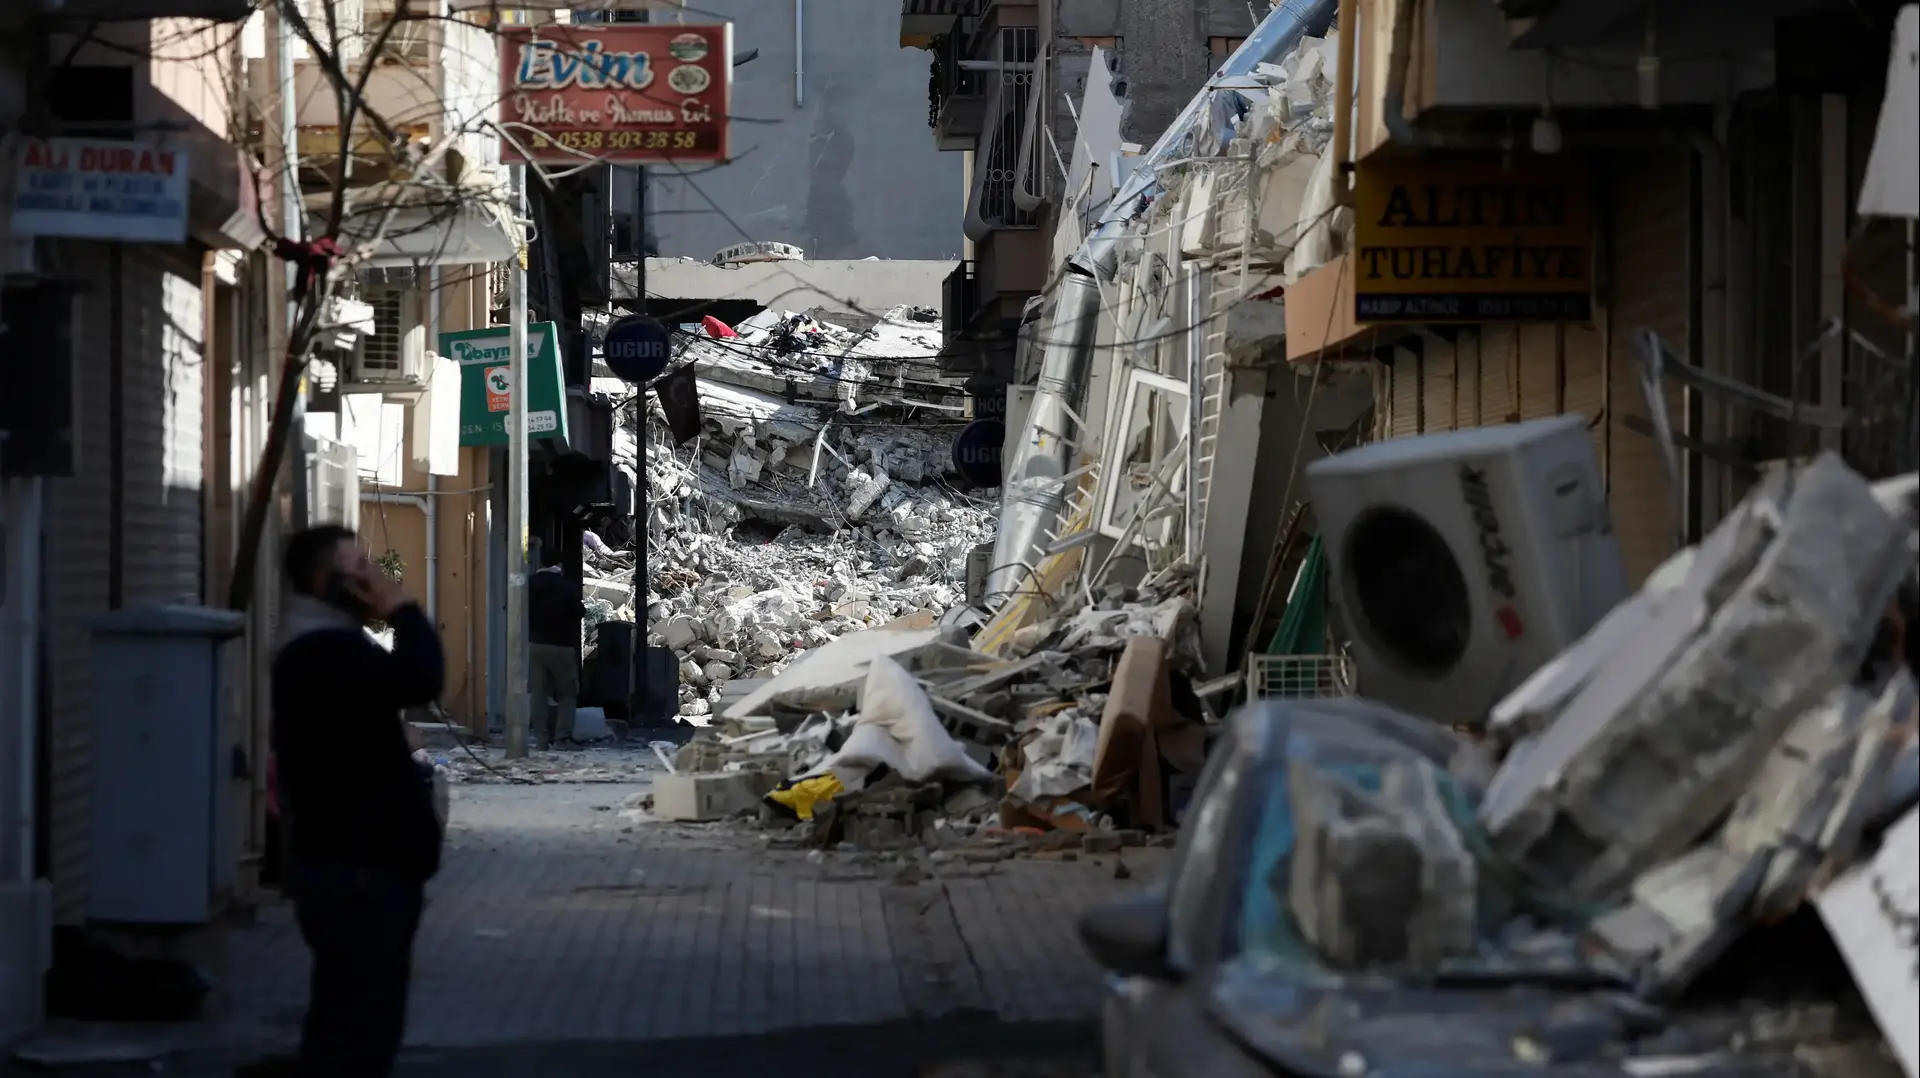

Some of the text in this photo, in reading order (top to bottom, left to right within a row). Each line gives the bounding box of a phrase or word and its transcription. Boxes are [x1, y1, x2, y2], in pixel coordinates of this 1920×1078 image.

[515, 40, 653, 89] Evim
[579, 109, 600, 123] ve
[681, 98, 712, 123] Evi
[558, 131, 602, 149] 0538
[673, 131, 697, 149] 58
[79, 147, 175, 176] DURAN
[608, 338, 665, 358] UĞUR
[977, 396, 1005, 414] HOC
[962, 444, 1001, 464] UĞU
